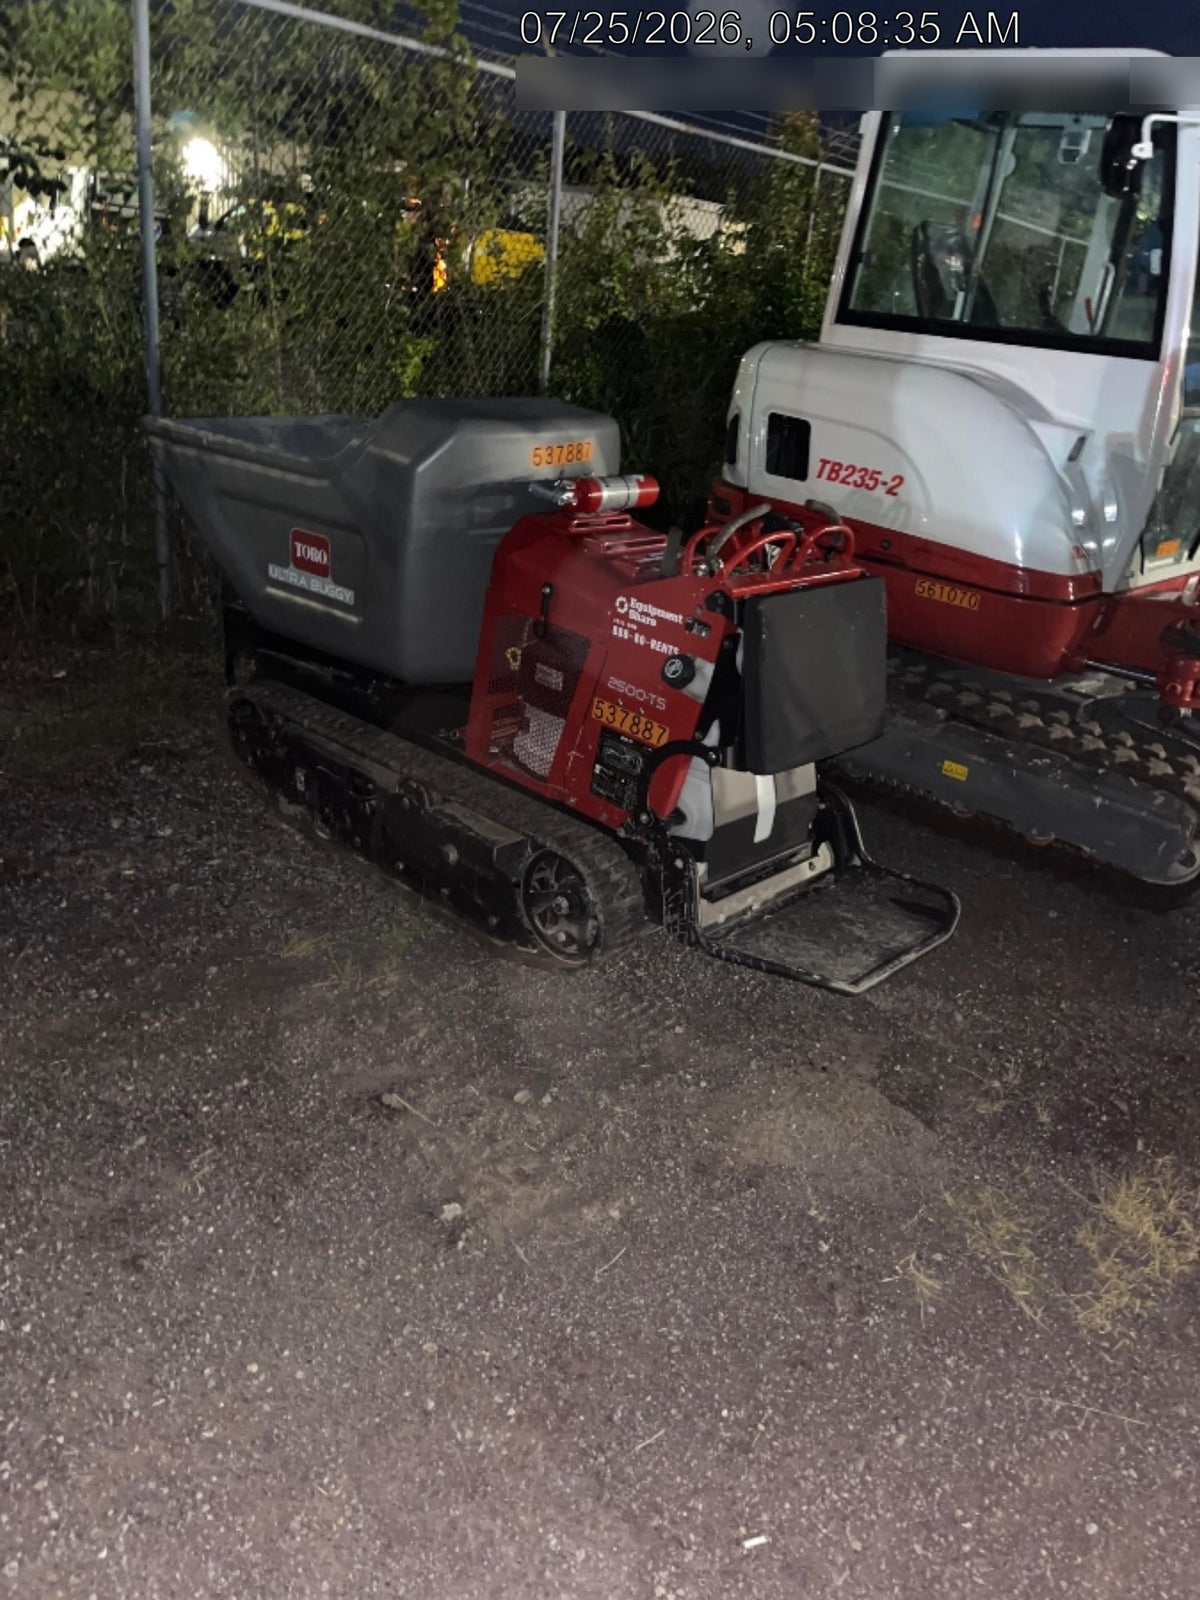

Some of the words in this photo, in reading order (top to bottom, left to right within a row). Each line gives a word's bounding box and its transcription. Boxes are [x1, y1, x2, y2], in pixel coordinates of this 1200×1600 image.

[532, 442, 592, 467] 537887
[816, 458, 905, 497] TB235-2
[294, 541, 328, 565] TORO
[268, 564, 308, 589] ULTRA
[310, 578, 354, 604] BUGGY
[916, 579, 980, 609] 561070
[628, 609, 657, 627] Share
[630, 597, 684, 624] Equipment
[607, 676, 667, 710] 2500-TS
[594, 700, 667, 745] 537887
